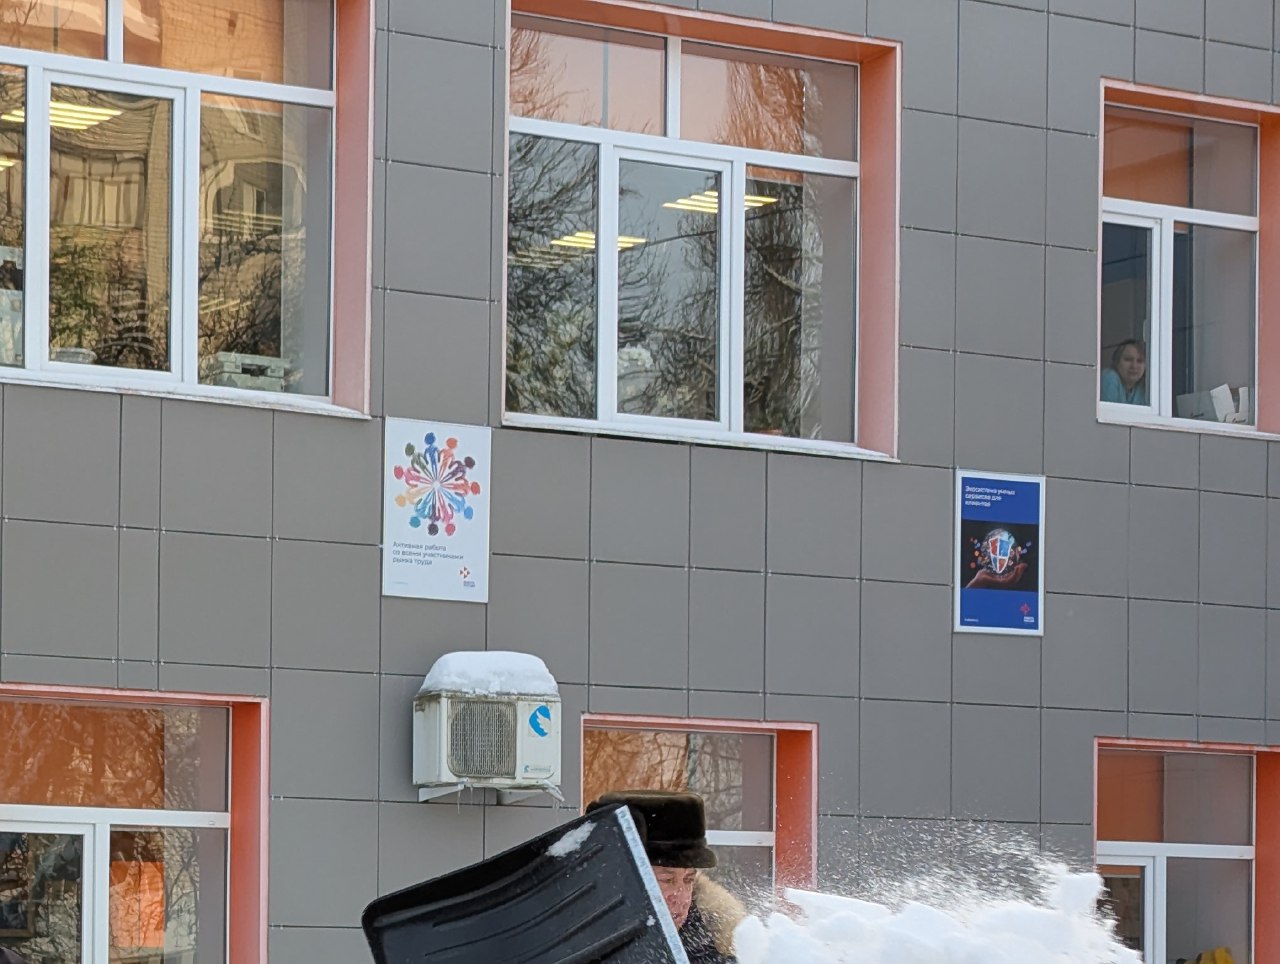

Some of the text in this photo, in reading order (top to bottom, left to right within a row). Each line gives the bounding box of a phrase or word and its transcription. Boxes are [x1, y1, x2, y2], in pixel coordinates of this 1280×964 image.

[393, 541, 446, 552] Активная работа
[422, 551, 464, 560] участниками
[392, 557, 432, 566] рынка труда
